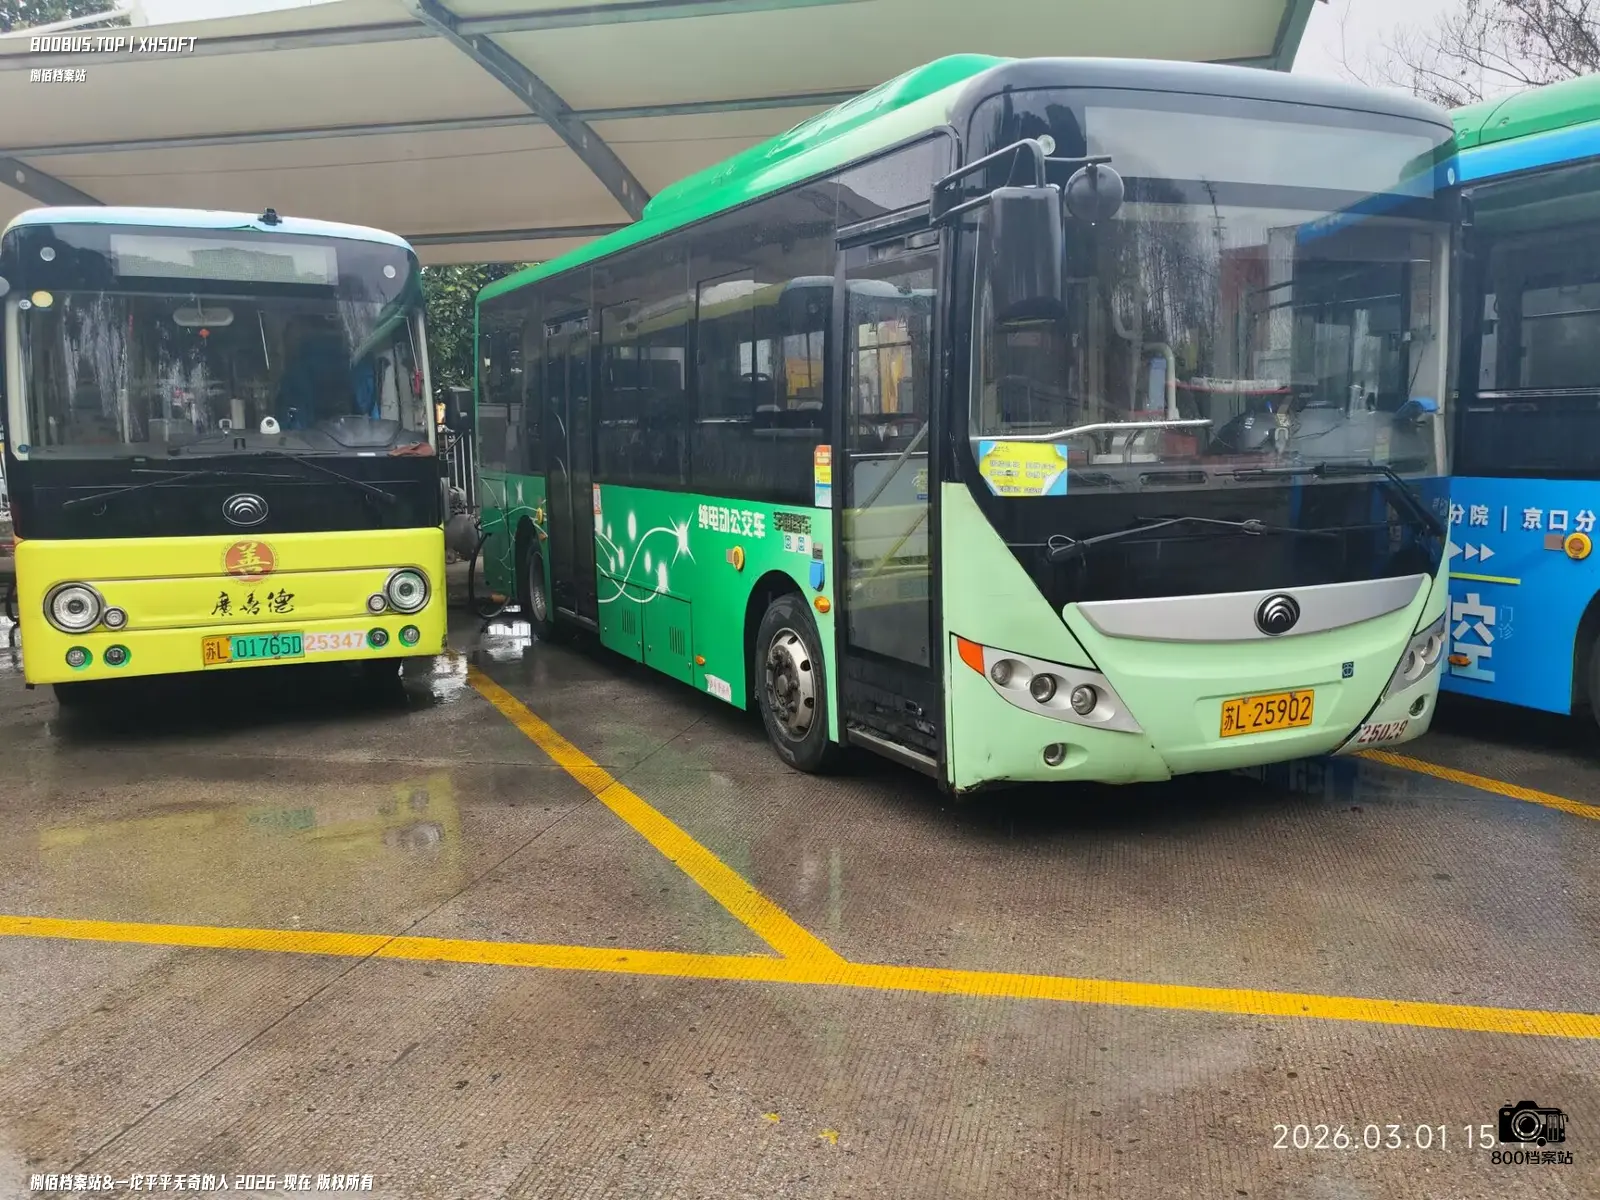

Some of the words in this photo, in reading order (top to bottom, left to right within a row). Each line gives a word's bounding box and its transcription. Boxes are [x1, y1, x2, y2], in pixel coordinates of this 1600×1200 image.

[698, 504, 765, 538] 纯电动公交车
[1523, 507, 1597, 532] 京口分
[305, 633, 364, 650] 25347
